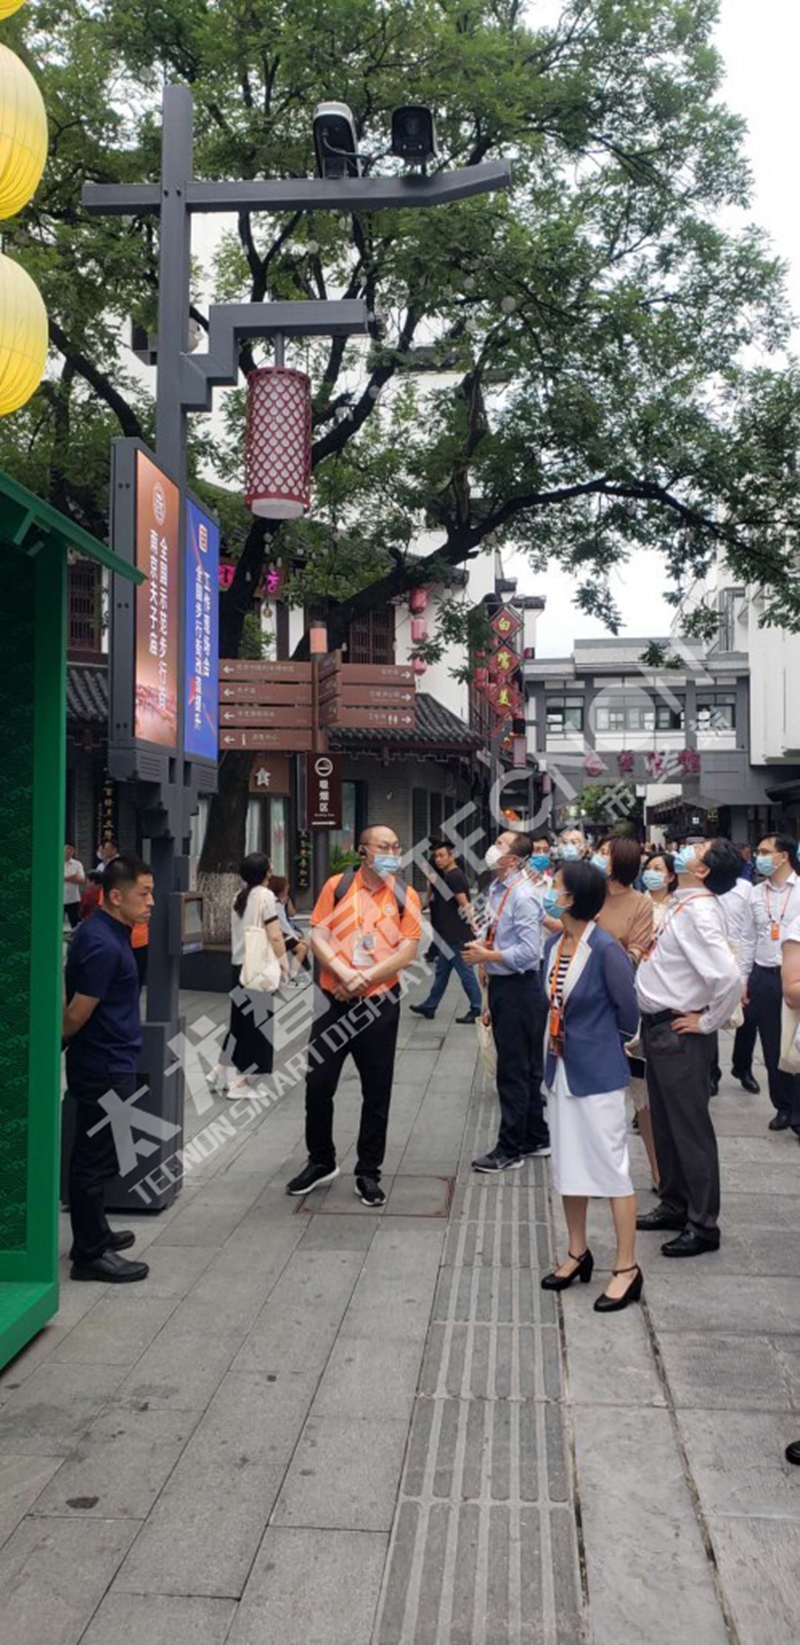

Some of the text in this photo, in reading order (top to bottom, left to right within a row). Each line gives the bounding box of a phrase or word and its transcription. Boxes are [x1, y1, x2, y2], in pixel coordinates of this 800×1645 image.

[149, 529, 159, 656] 南京夫子庙
[255, 767, 271, 787] 食
[318, 779, 330, 813] 吸烟区
